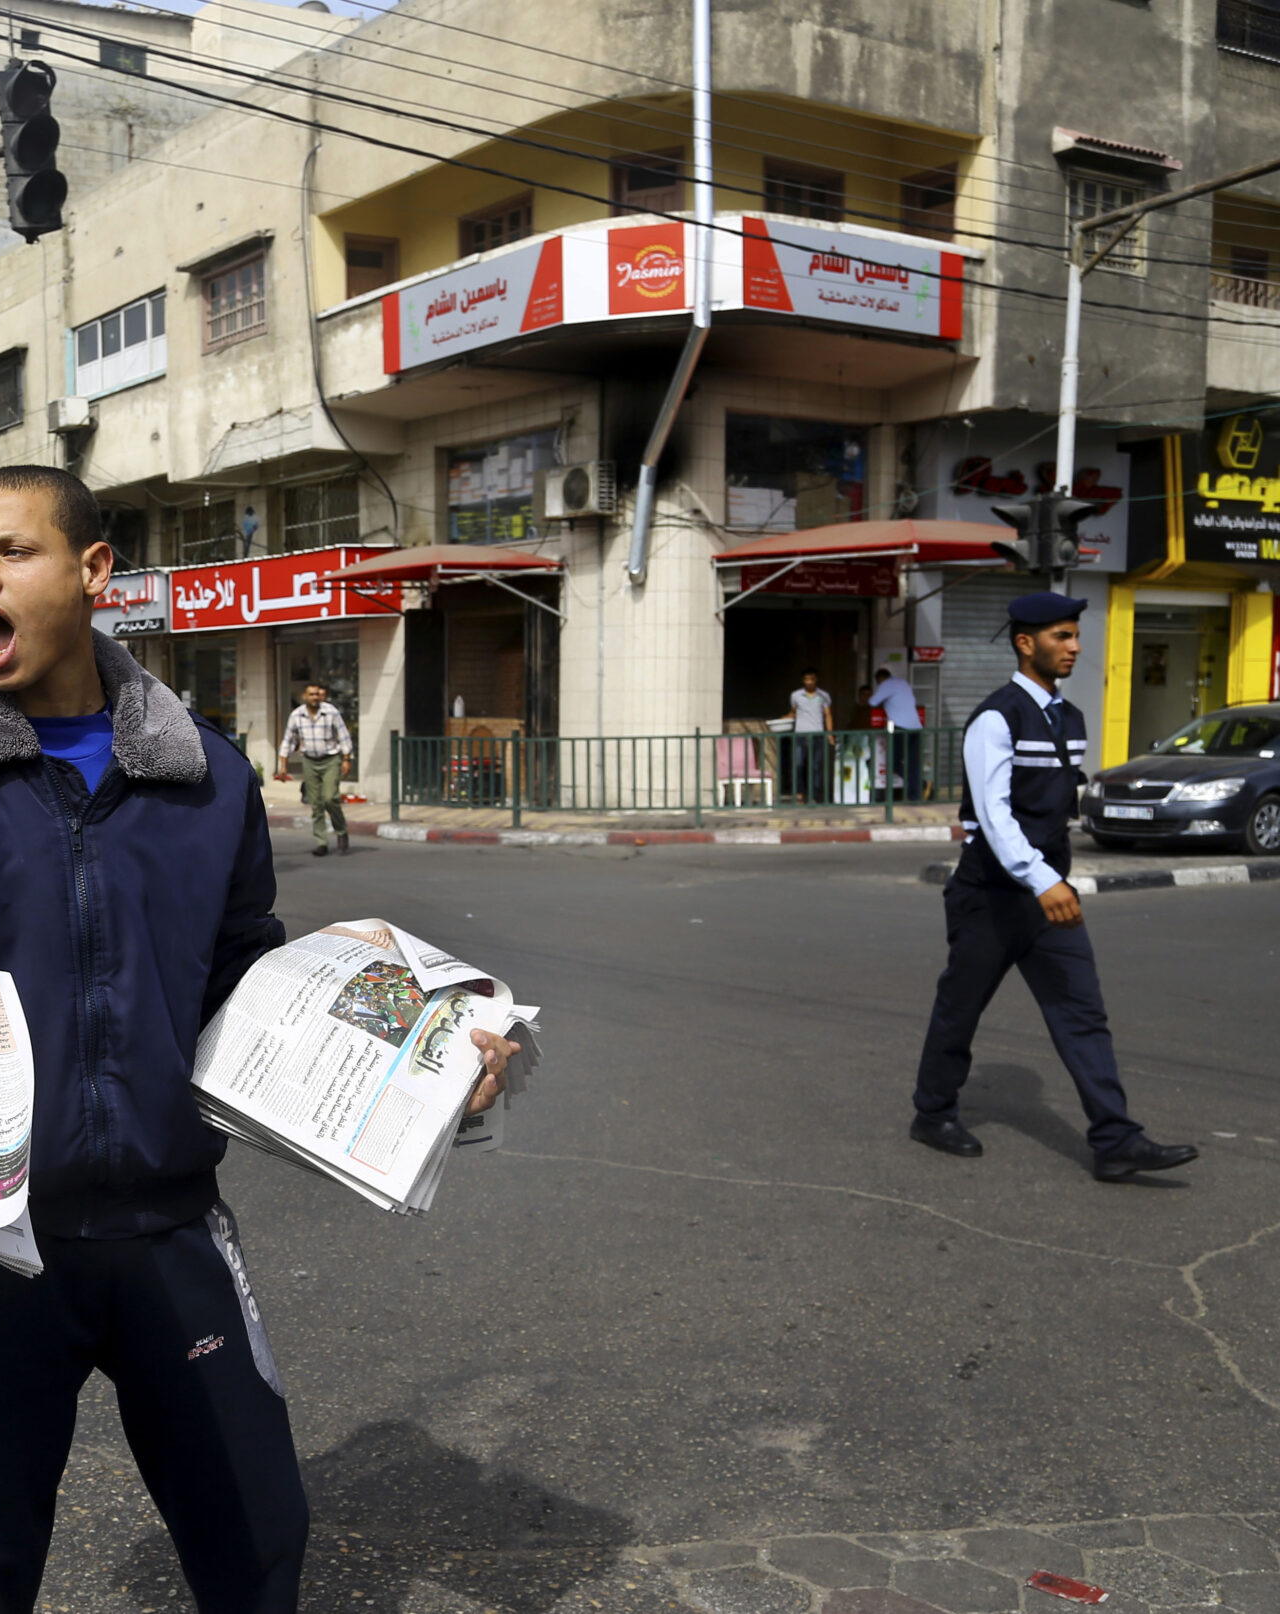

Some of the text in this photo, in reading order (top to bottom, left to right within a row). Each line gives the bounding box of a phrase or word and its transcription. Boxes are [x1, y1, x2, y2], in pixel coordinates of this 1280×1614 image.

[616, 259, 685, 287] Jasmin
[809, 245, 850, 276] الشام
[425, 290, 457, 326] الشام
[461, 278, 507, 314] ياسمين
[175, 570, 236, 618] للأحذية
[337, 1113, 347, 1128] قطر
[187, 1336, 224, 1360] SPORT
